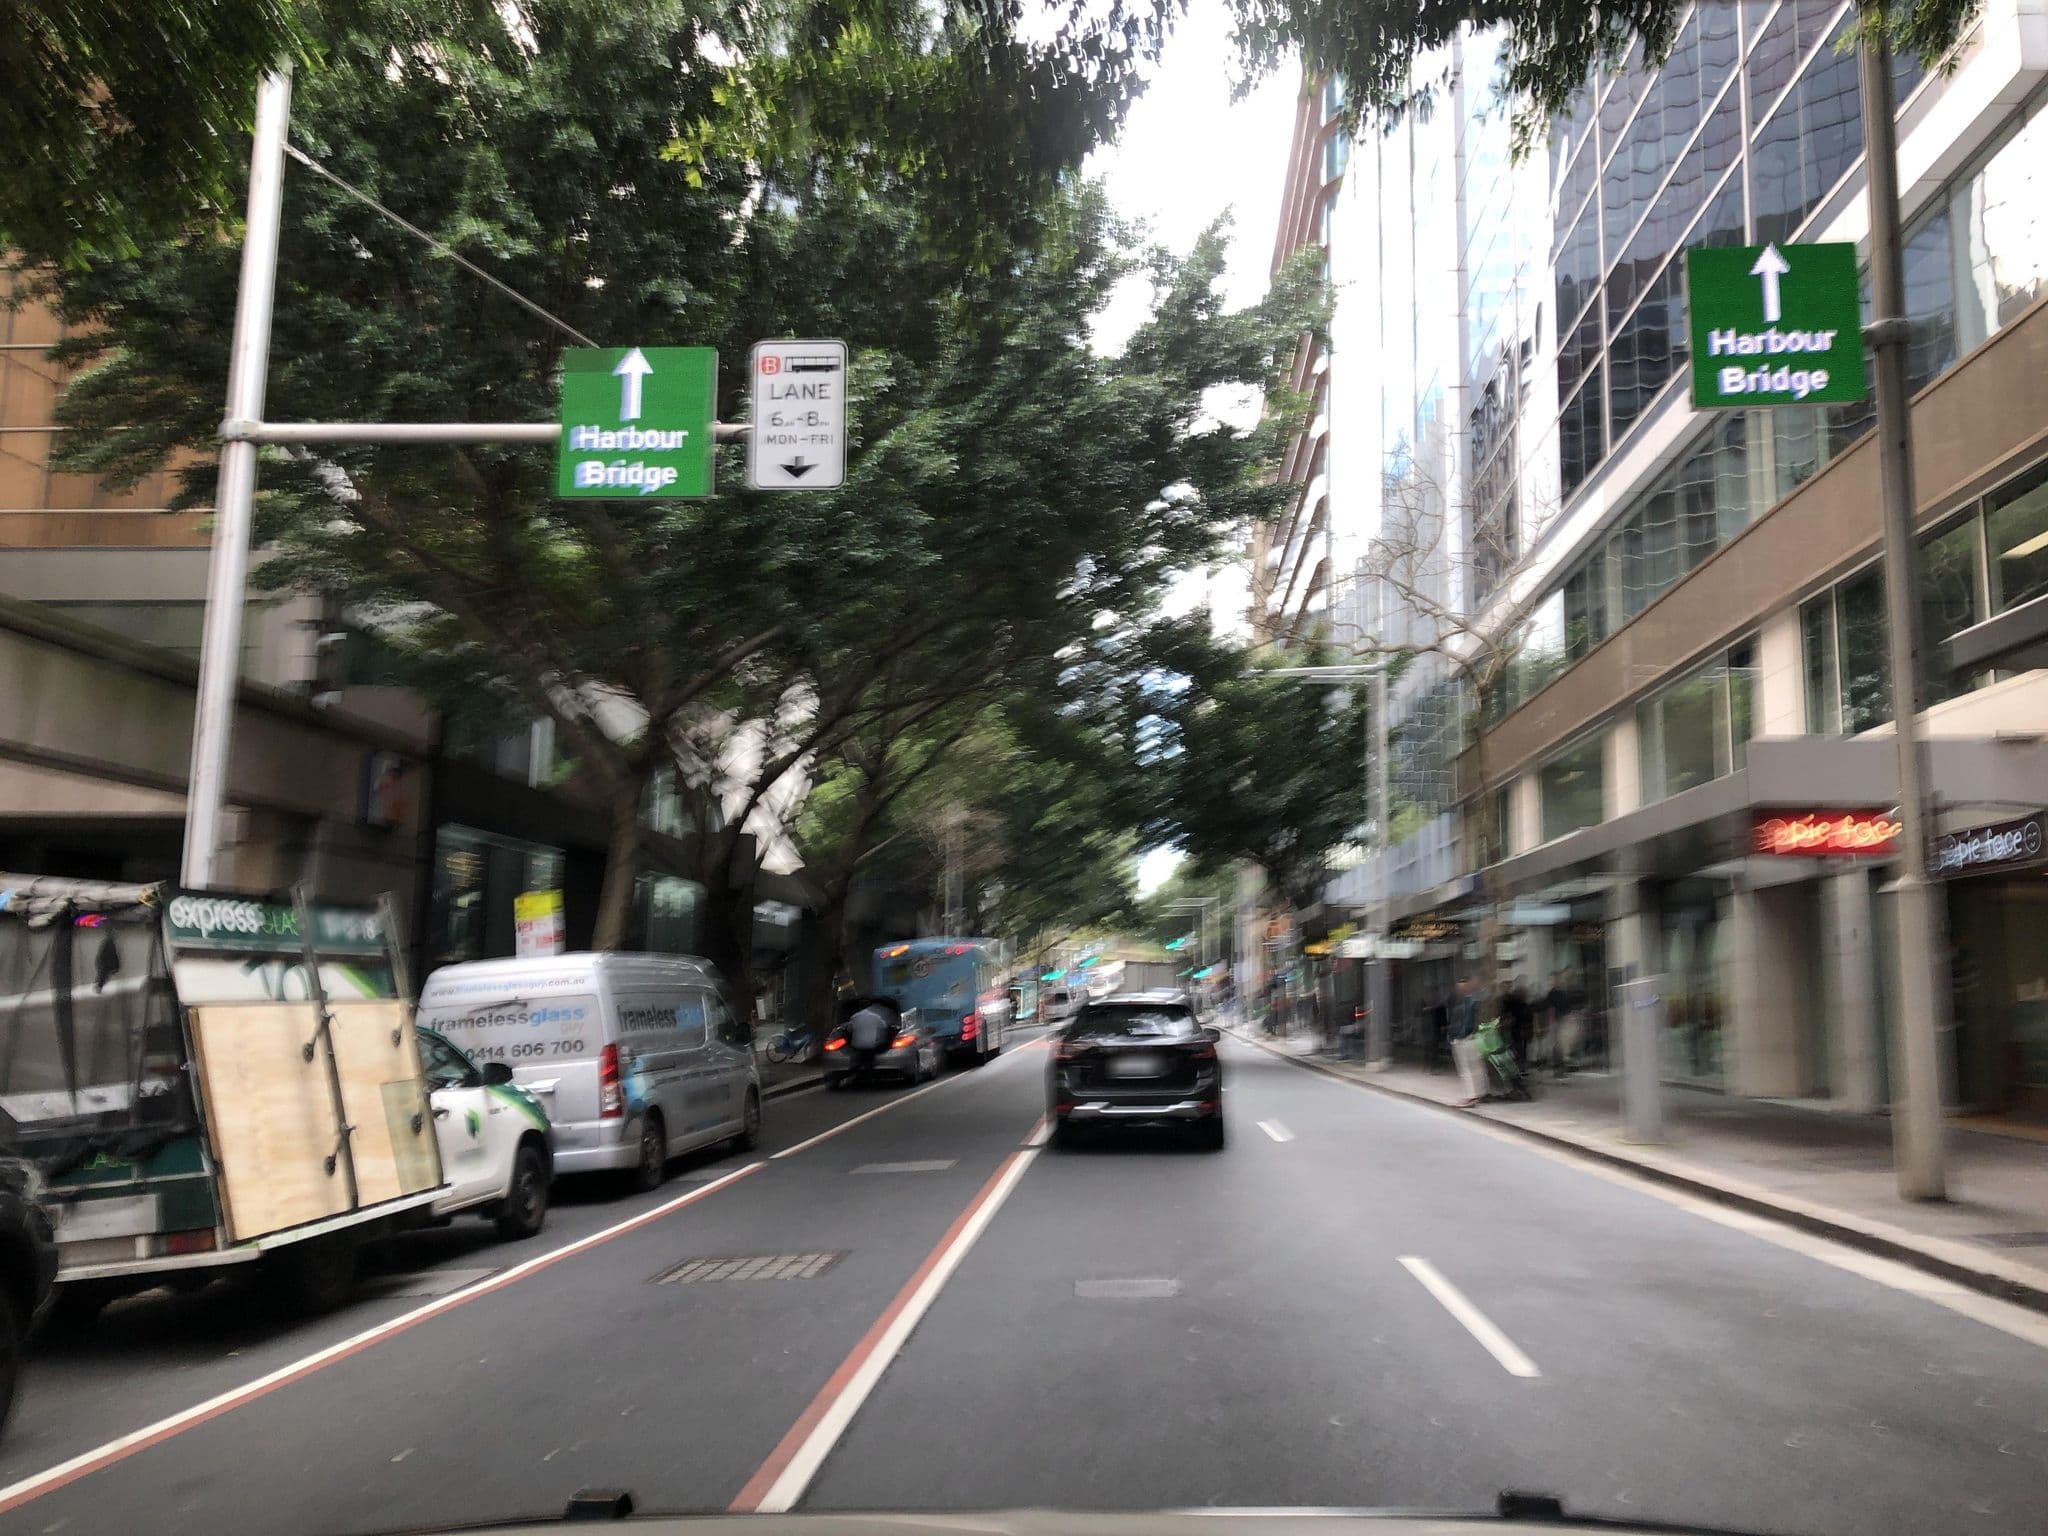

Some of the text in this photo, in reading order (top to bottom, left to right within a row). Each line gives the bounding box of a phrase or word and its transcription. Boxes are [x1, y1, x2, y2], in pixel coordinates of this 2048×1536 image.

[1708, 327, 1837, 356] Harbour
[770, 383, 831, 400] LANE
[1718, 364, 1830, 400] Bridge
[570, 424, 688, 450] Harbour
[575, 459, 678, 495] Bridge
[1957, 828, 2022, 869] pie face
[465, 1039, 585, 1061] 0414 606 700
